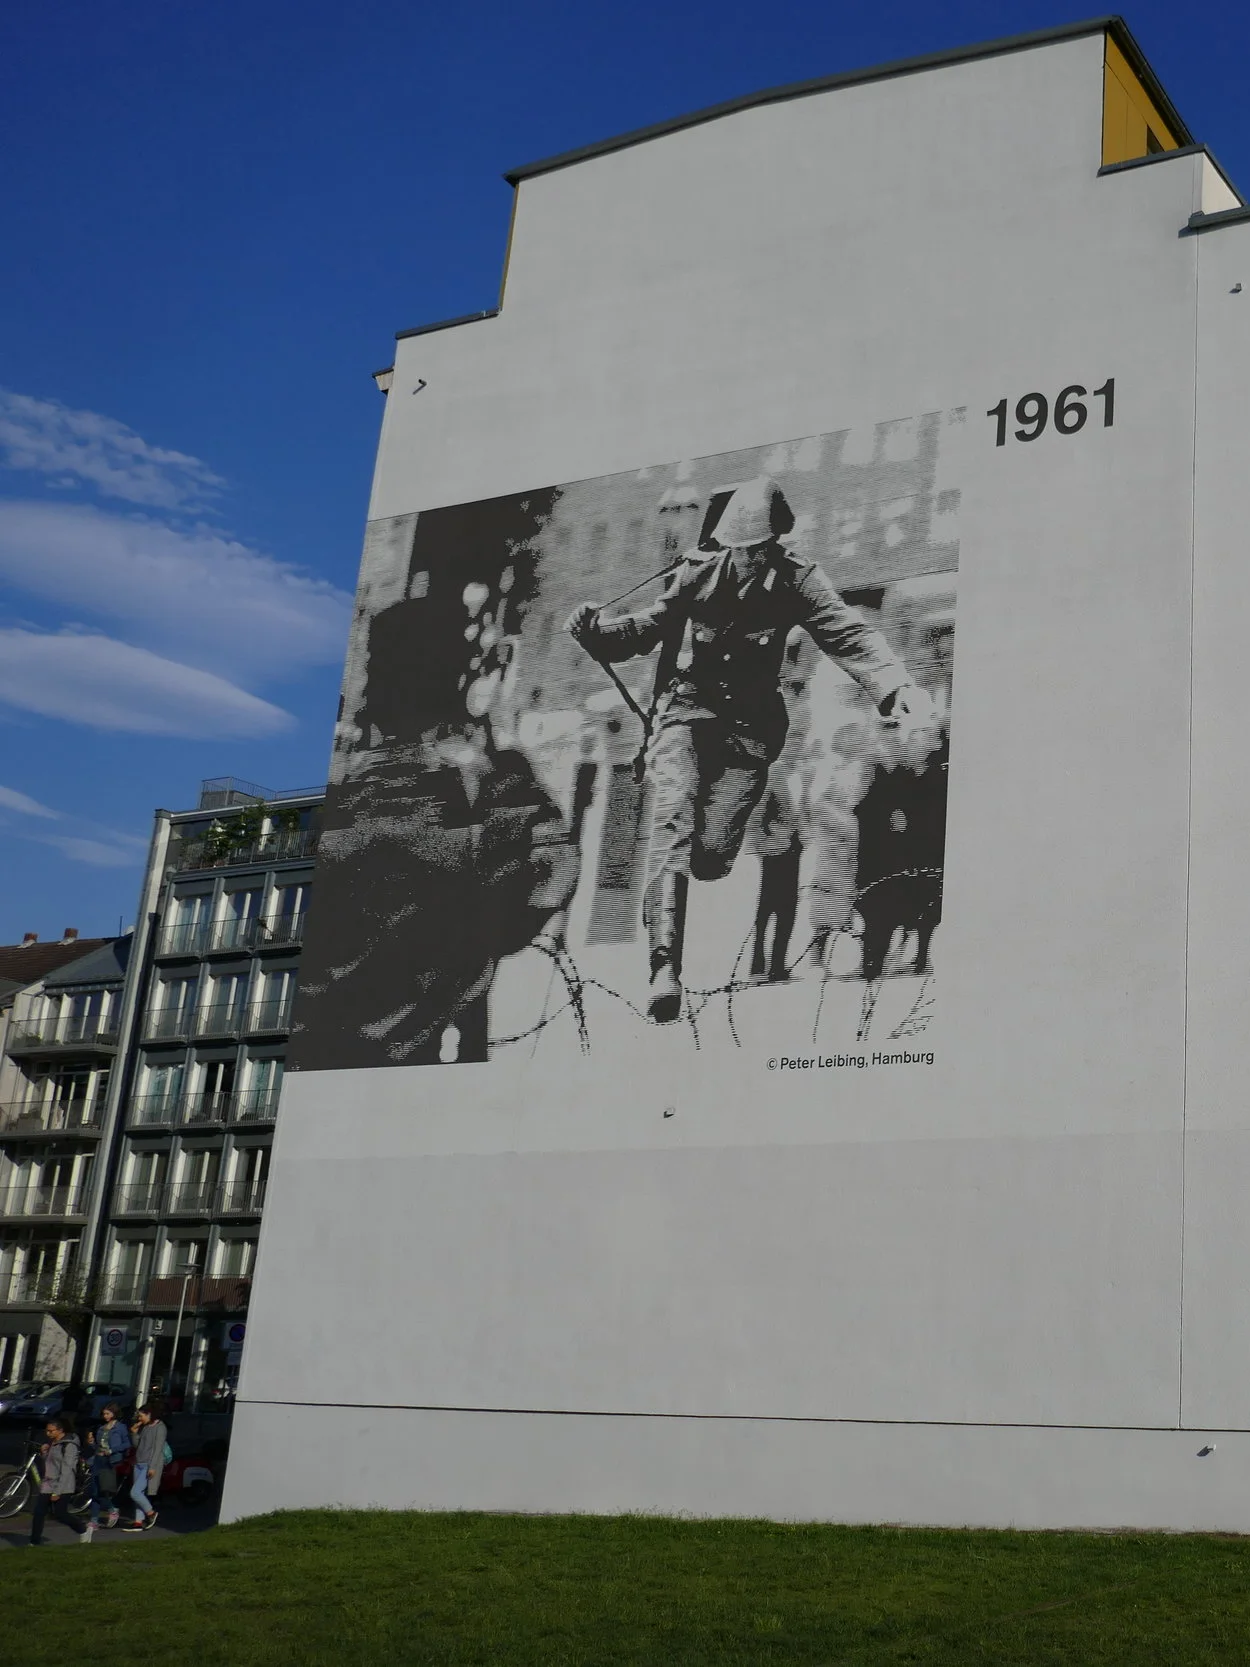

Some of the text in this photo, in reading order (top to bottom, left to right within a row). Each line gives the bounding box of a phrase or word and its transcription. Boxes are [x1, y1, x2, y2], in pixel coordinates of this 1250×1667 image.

[986, 378, 1115, 447] 1961
[780, 1057, 815, 1070] Peter
[818, 1054, 868, 1069] Leibing,
[872, 1051, 934, 1065] Hamburg
